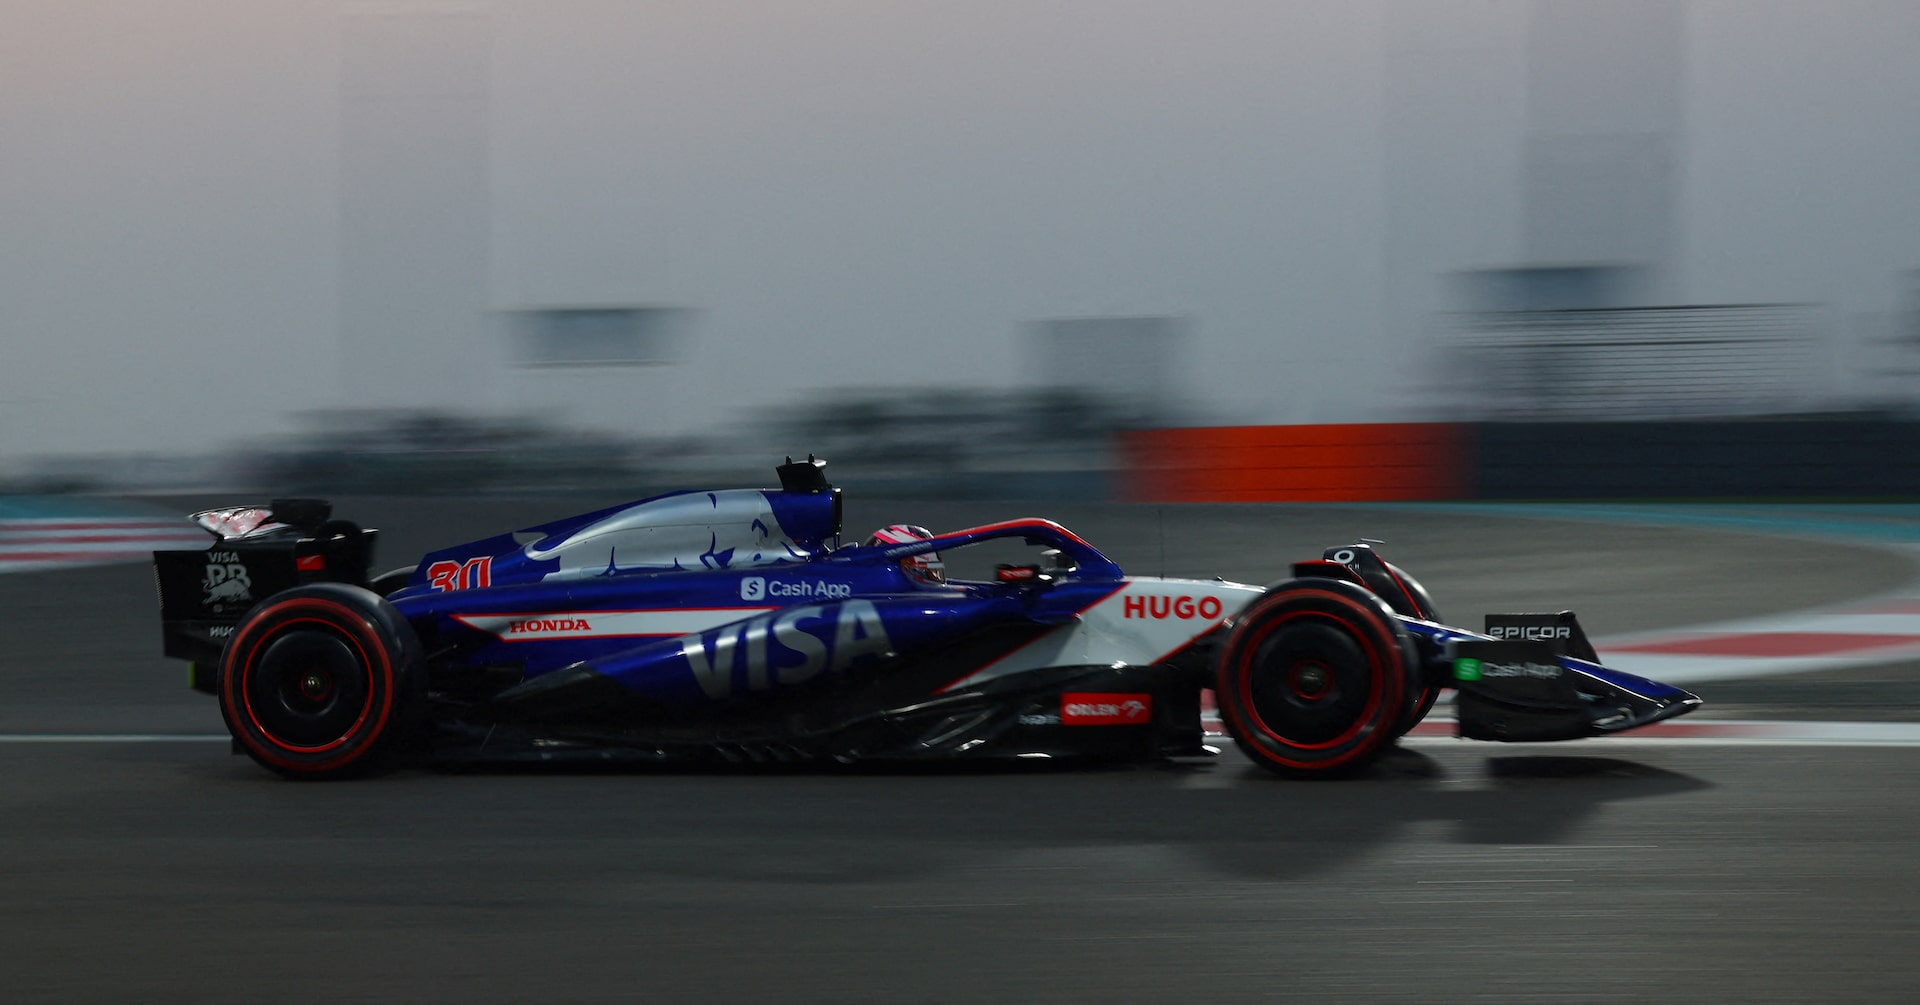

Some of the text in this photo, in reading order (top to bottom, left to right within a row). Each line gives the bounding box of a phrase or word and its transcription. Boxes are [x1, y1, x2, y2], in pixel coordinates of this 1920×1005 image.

[207, 552, 240, 564] VISA
[426, 556, 494, 592] 30
[768, 580, 812, 597] Cash
[815, 580, 851, 599] App
[1124, 595, 1222, 620] HUGO
[509, 619, 591, 633] HONDA
[681, 599, 894, 700] VISA
